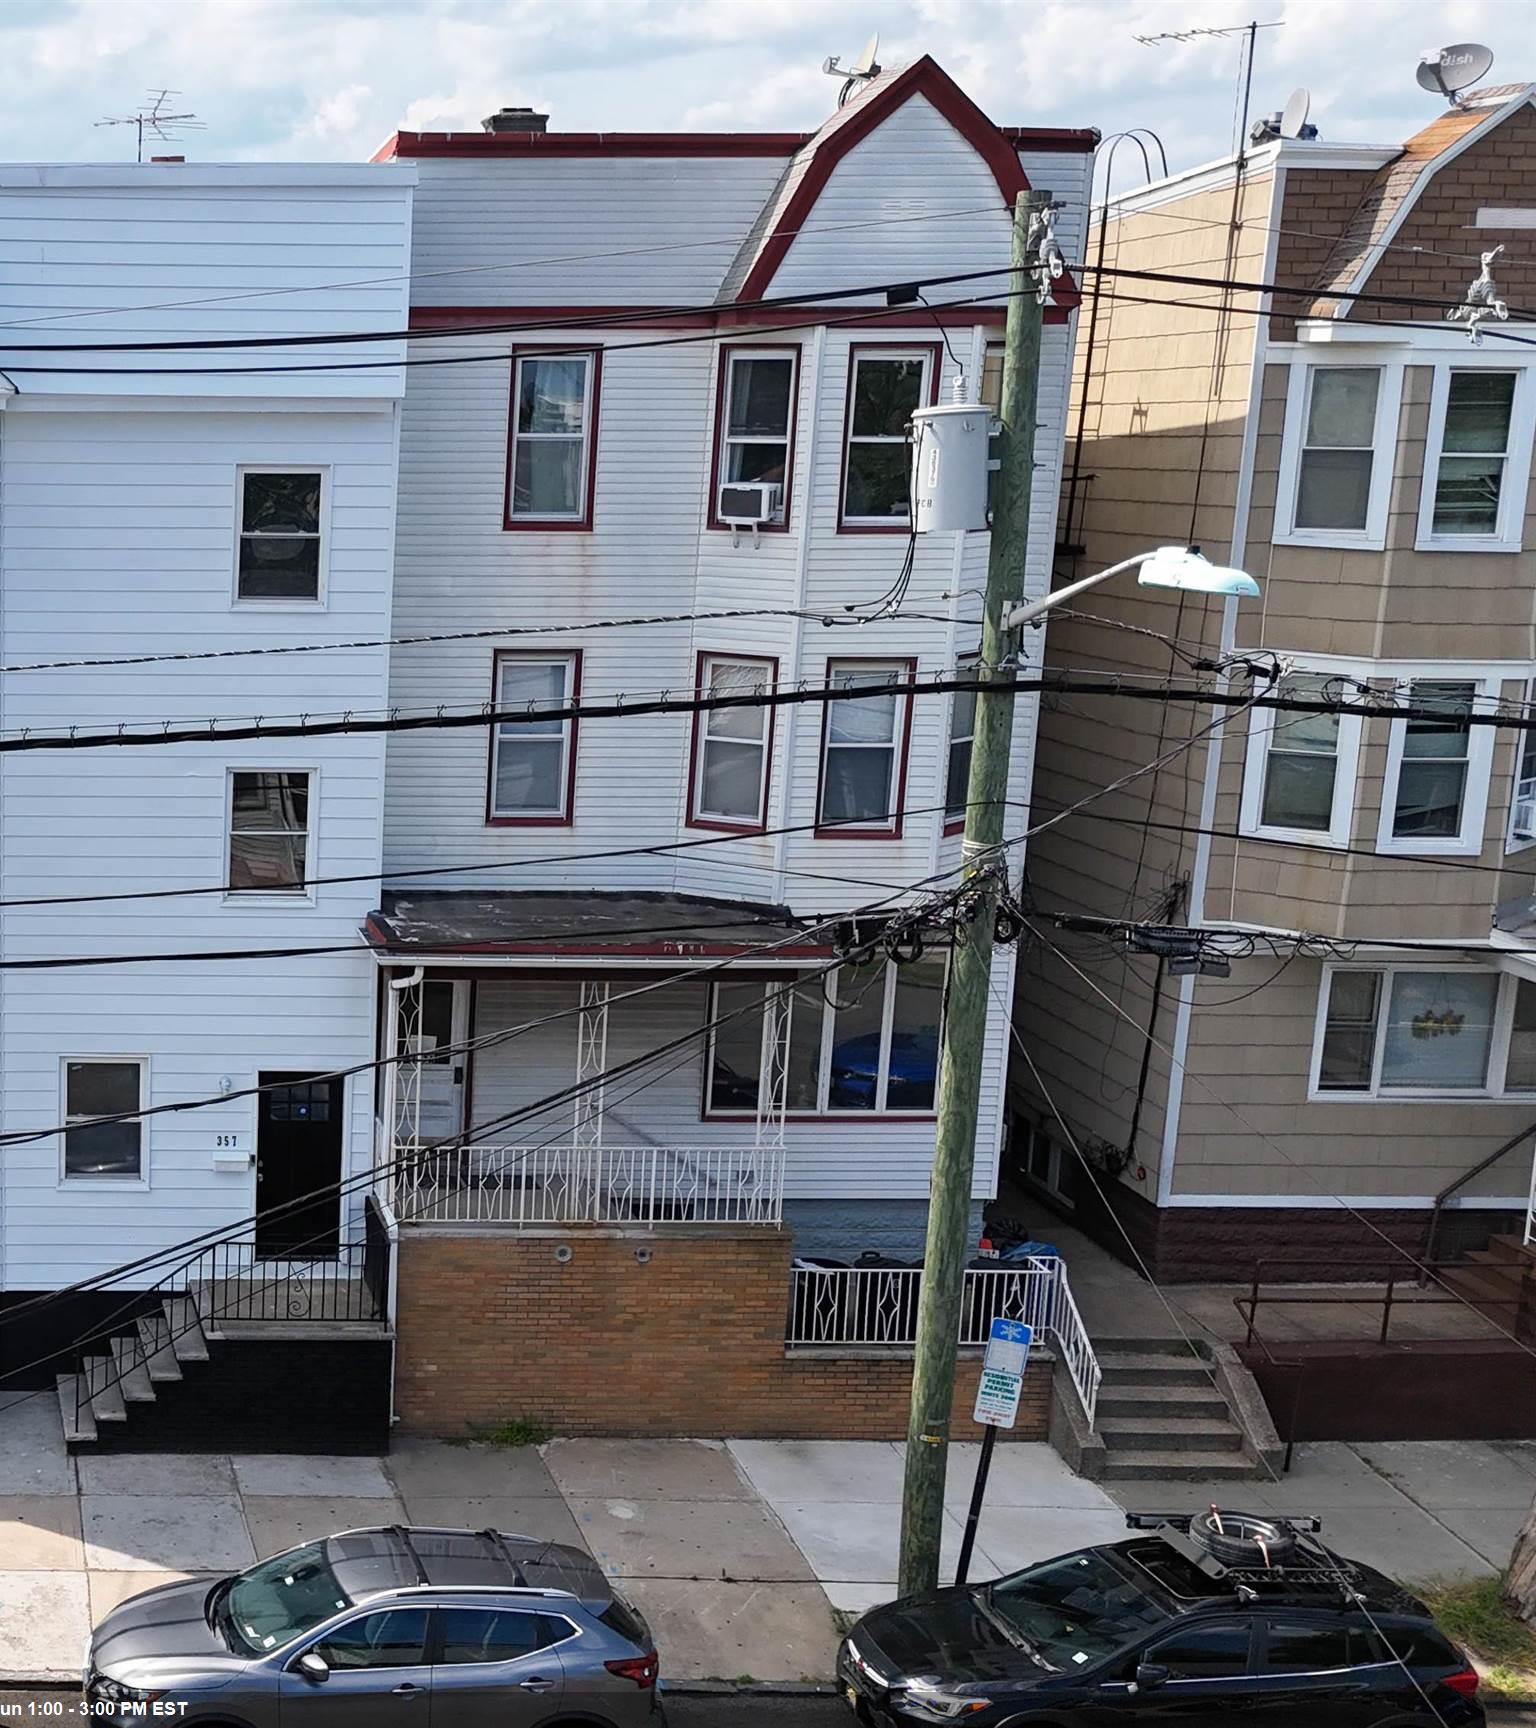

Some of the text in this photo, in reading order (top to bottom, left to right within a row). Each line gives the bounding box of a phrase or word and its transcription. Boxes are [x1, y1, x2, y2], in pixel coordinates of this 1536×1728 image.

[1441, 53, 1473, 66] dish
[216, 1135, 237, 1147] 357
[986, 1378, 1014, 1388] PERMIT
[984, 1384, 1015, 1395] PARKING
